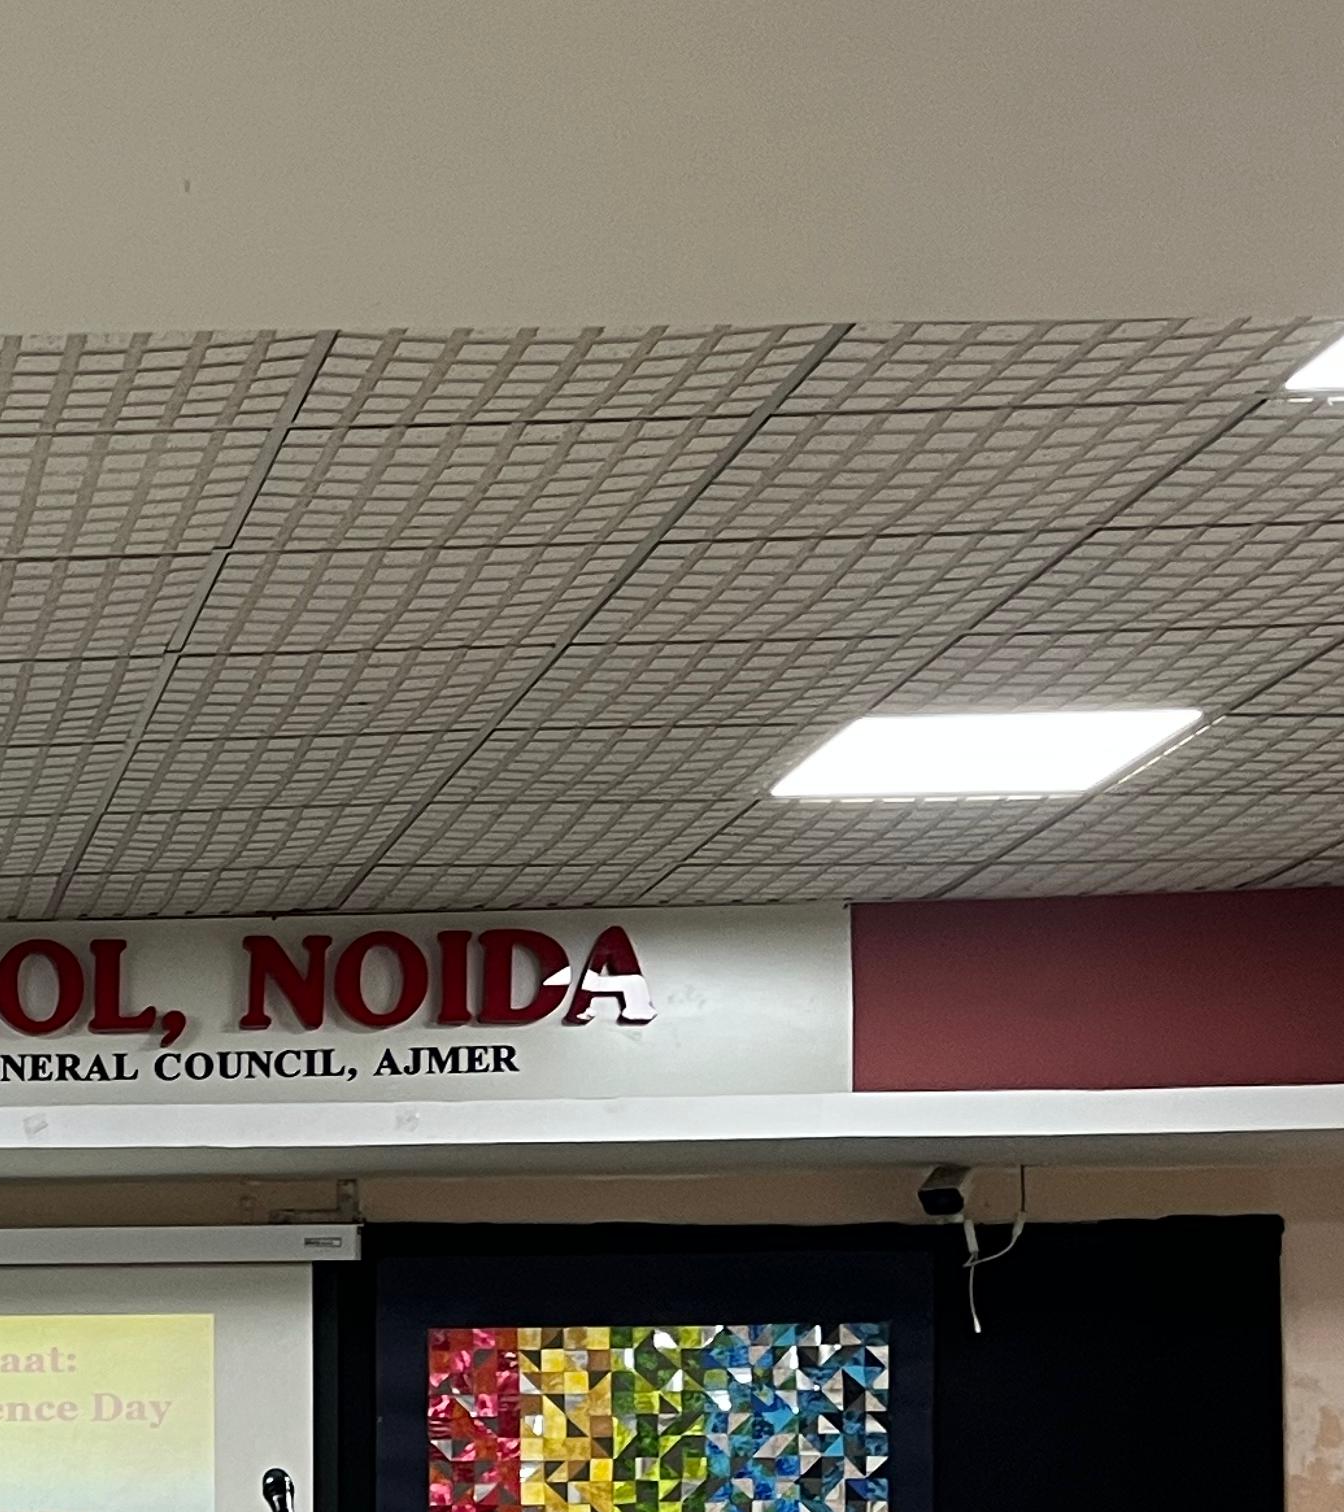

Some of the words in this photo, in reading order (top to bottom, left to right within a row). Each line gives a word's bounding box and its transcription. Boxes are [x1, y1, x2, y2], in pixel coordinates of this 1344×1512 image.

[240, 925, 659, 1030] NOIDA
[153, 1048, 359, 1081] COUNCIL,
[372, 1044, 520, 1077] AJMER
[90, 1392, 174, 1429] Day
